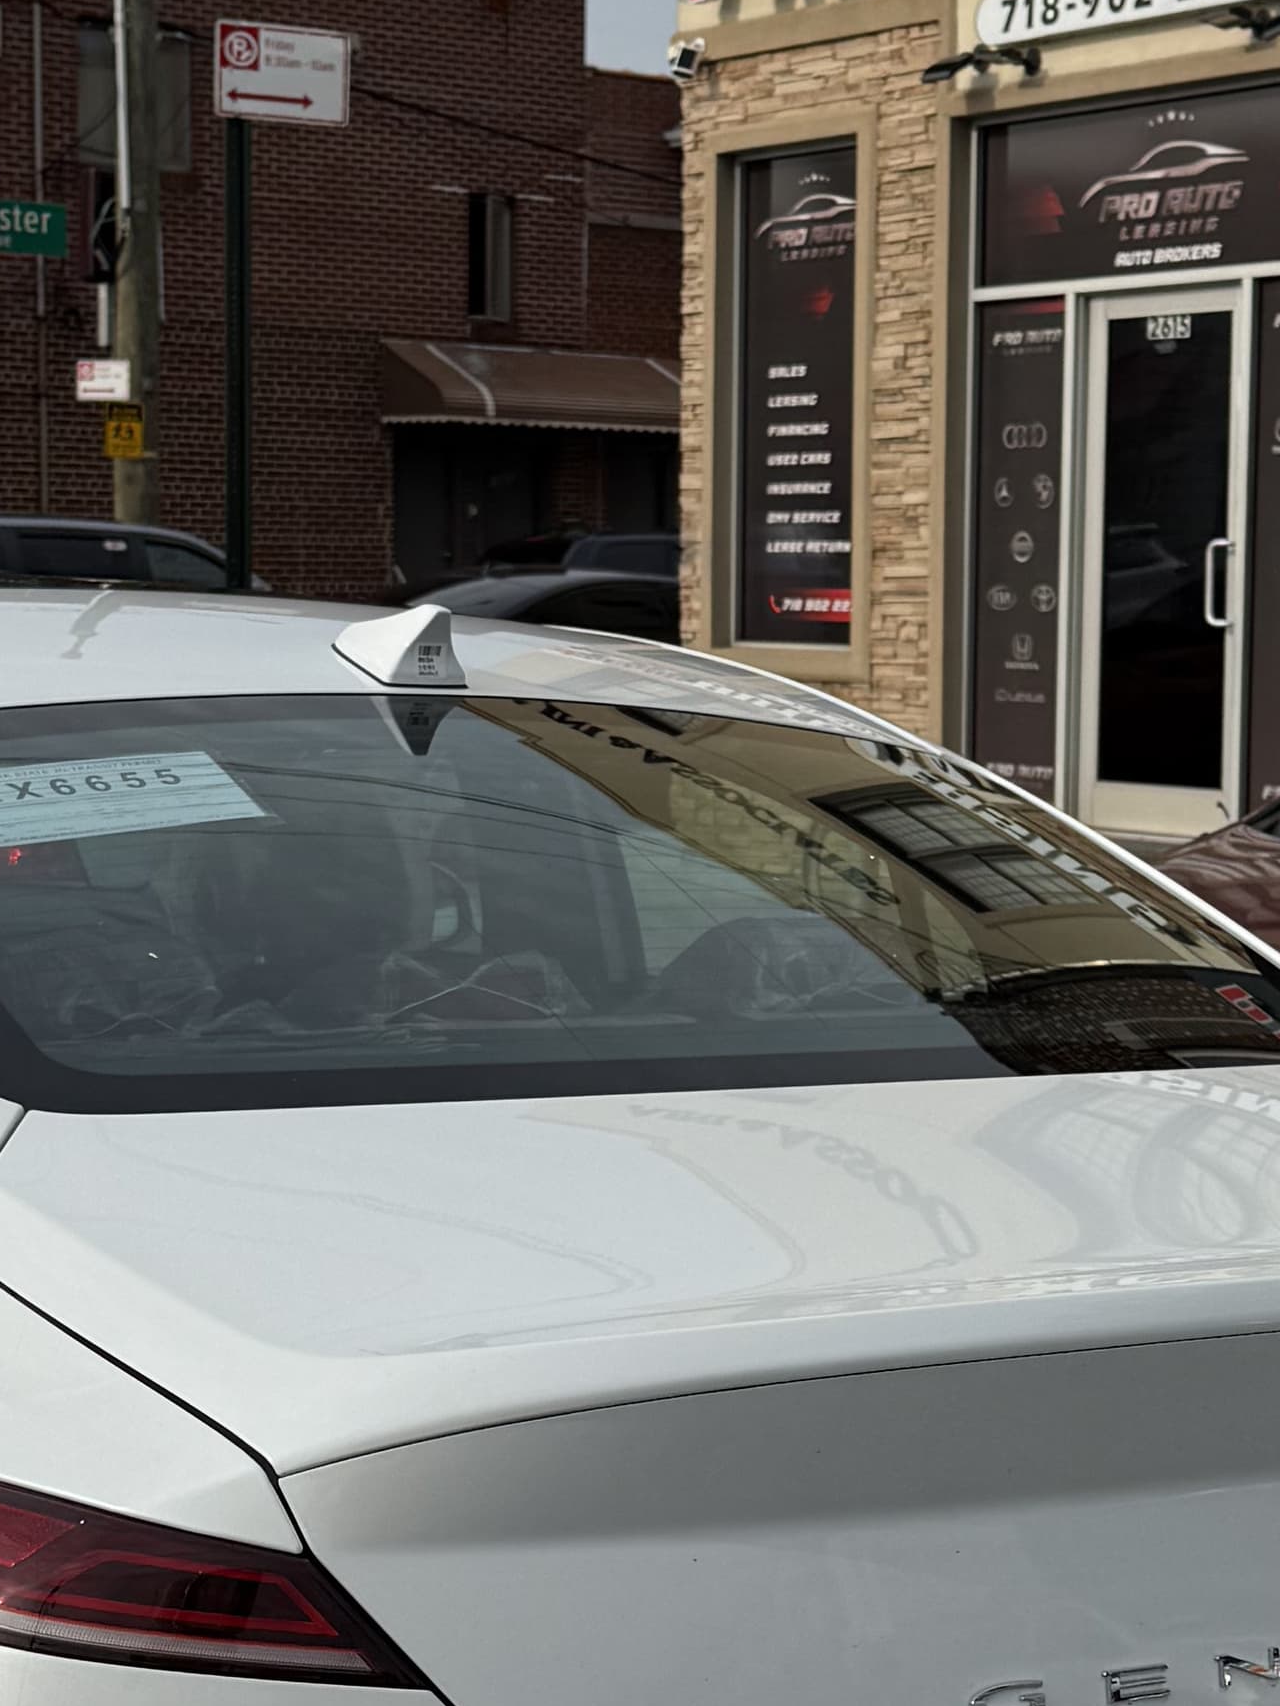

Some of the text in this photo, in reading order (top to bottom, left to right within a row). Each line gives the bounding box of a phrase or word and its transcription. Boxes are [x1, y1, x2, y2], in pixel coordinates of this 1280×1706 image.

[1099, 180, 1244, 222] PRO AUTO
[1120, 217, 1219, 241] LEASING
[1114, 242, 1223, 268] AUTO BROKERS
[1148, 316, 1192, 340] 2615
[768, 365, 808, 379] SALES
[767, 393, 818, 408] LEASING
[767, 423, 830, 437] FINANCING
[767, 452, 832, 466] USED CARS
[766, 482, 832, 495] INSURANCE
[791, 510, 841, 523] SERVICE
[765, 541, 804, 553] LEASE
